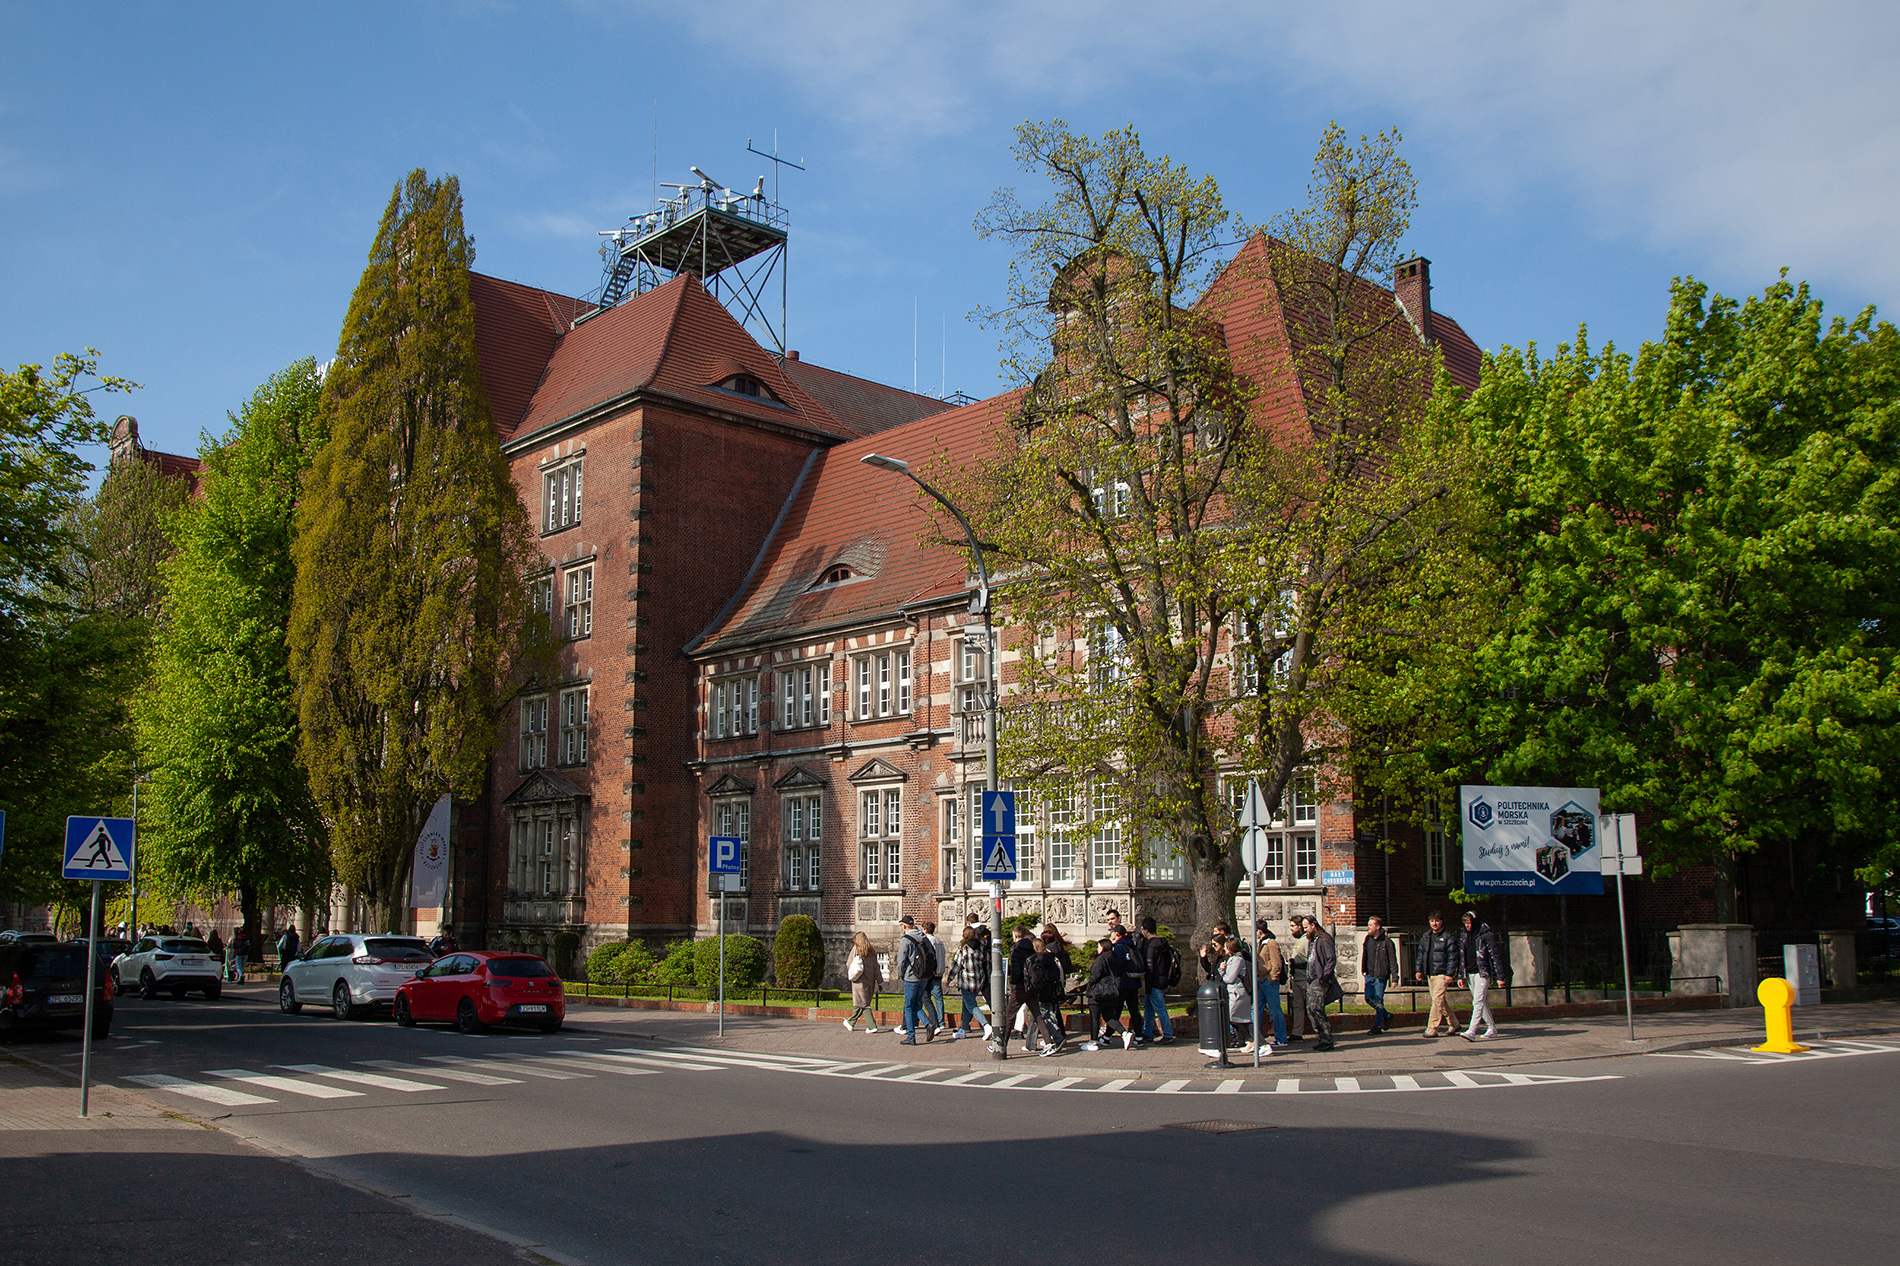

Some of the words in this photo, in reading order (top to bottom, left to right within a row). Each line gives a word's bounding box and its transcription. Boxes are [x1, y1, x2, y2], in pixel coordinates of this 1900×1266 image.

[1497, 801, 1550, 810] POLITECHNIKA
[1497, 810, 1529, 819] MORSKA
[1504, 844, 1510, 857] z
[1511, 836, 1530, 850] nami!
[716, 840, 735, 869] P
[1474, 879, 1536, 887] www.pm.szczecin.pl
